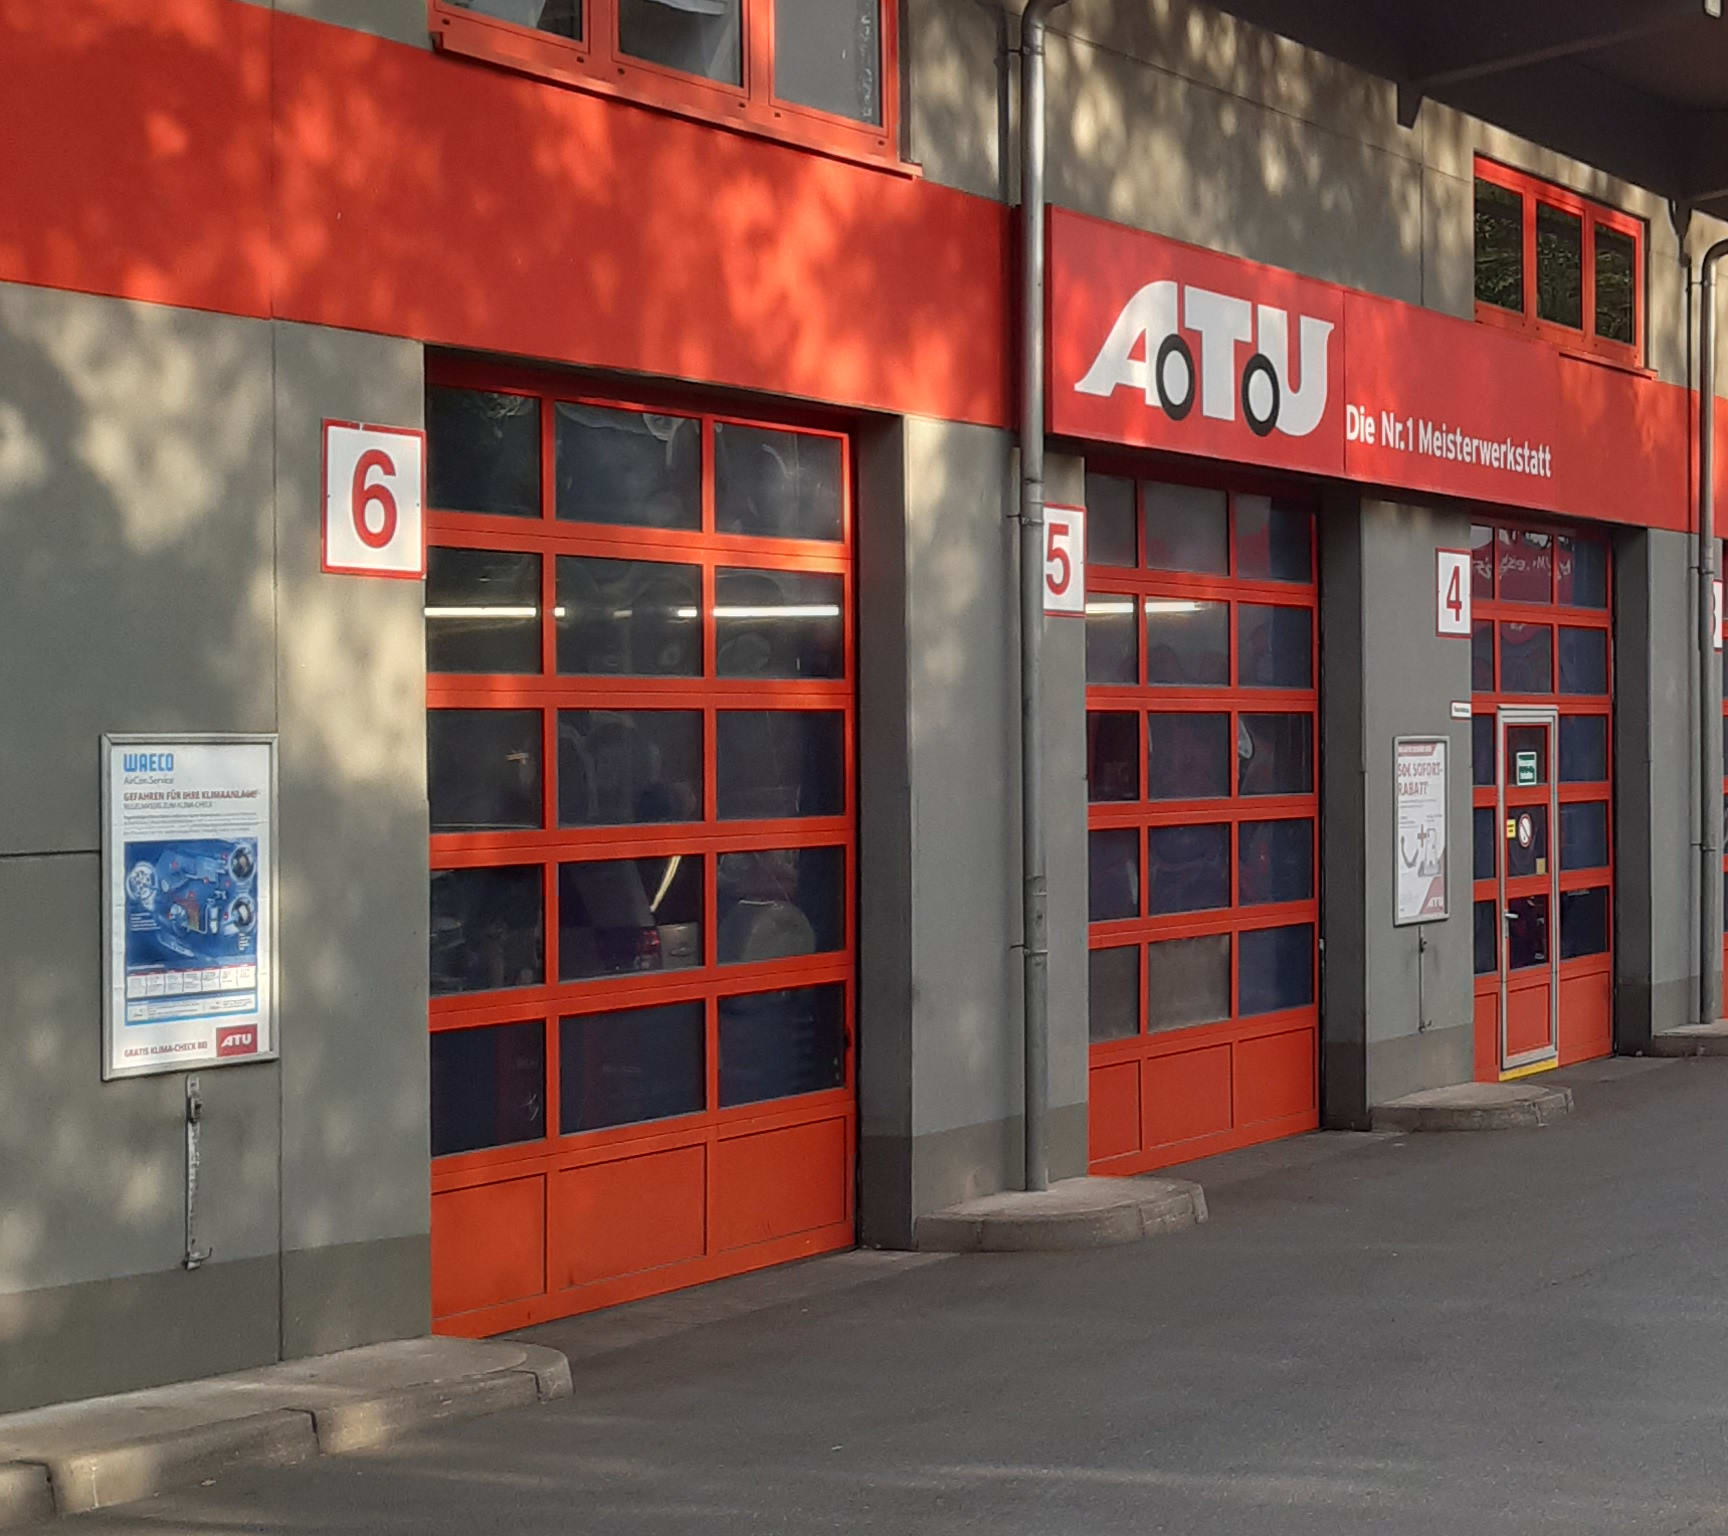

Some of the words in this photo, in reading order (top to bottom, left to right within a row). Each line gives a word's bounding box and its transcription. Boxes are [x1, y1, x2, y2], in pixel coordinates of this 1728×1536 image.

[1074, 280, 1335, 438] ATU
[1345, 404, 1376, 445] Die
[1418, 418, 1552, 478] Meisterwerkstatt
[351, 448, 398, 549] 6
[1046, 522, 1071, 596] 5
[1446, 565, 1463, 622] 4
[123, 753, 175, 773] WAECO
[123, 791, 165, 802] GEFAHREN
[221, 1033, 253, 1048] ATU
